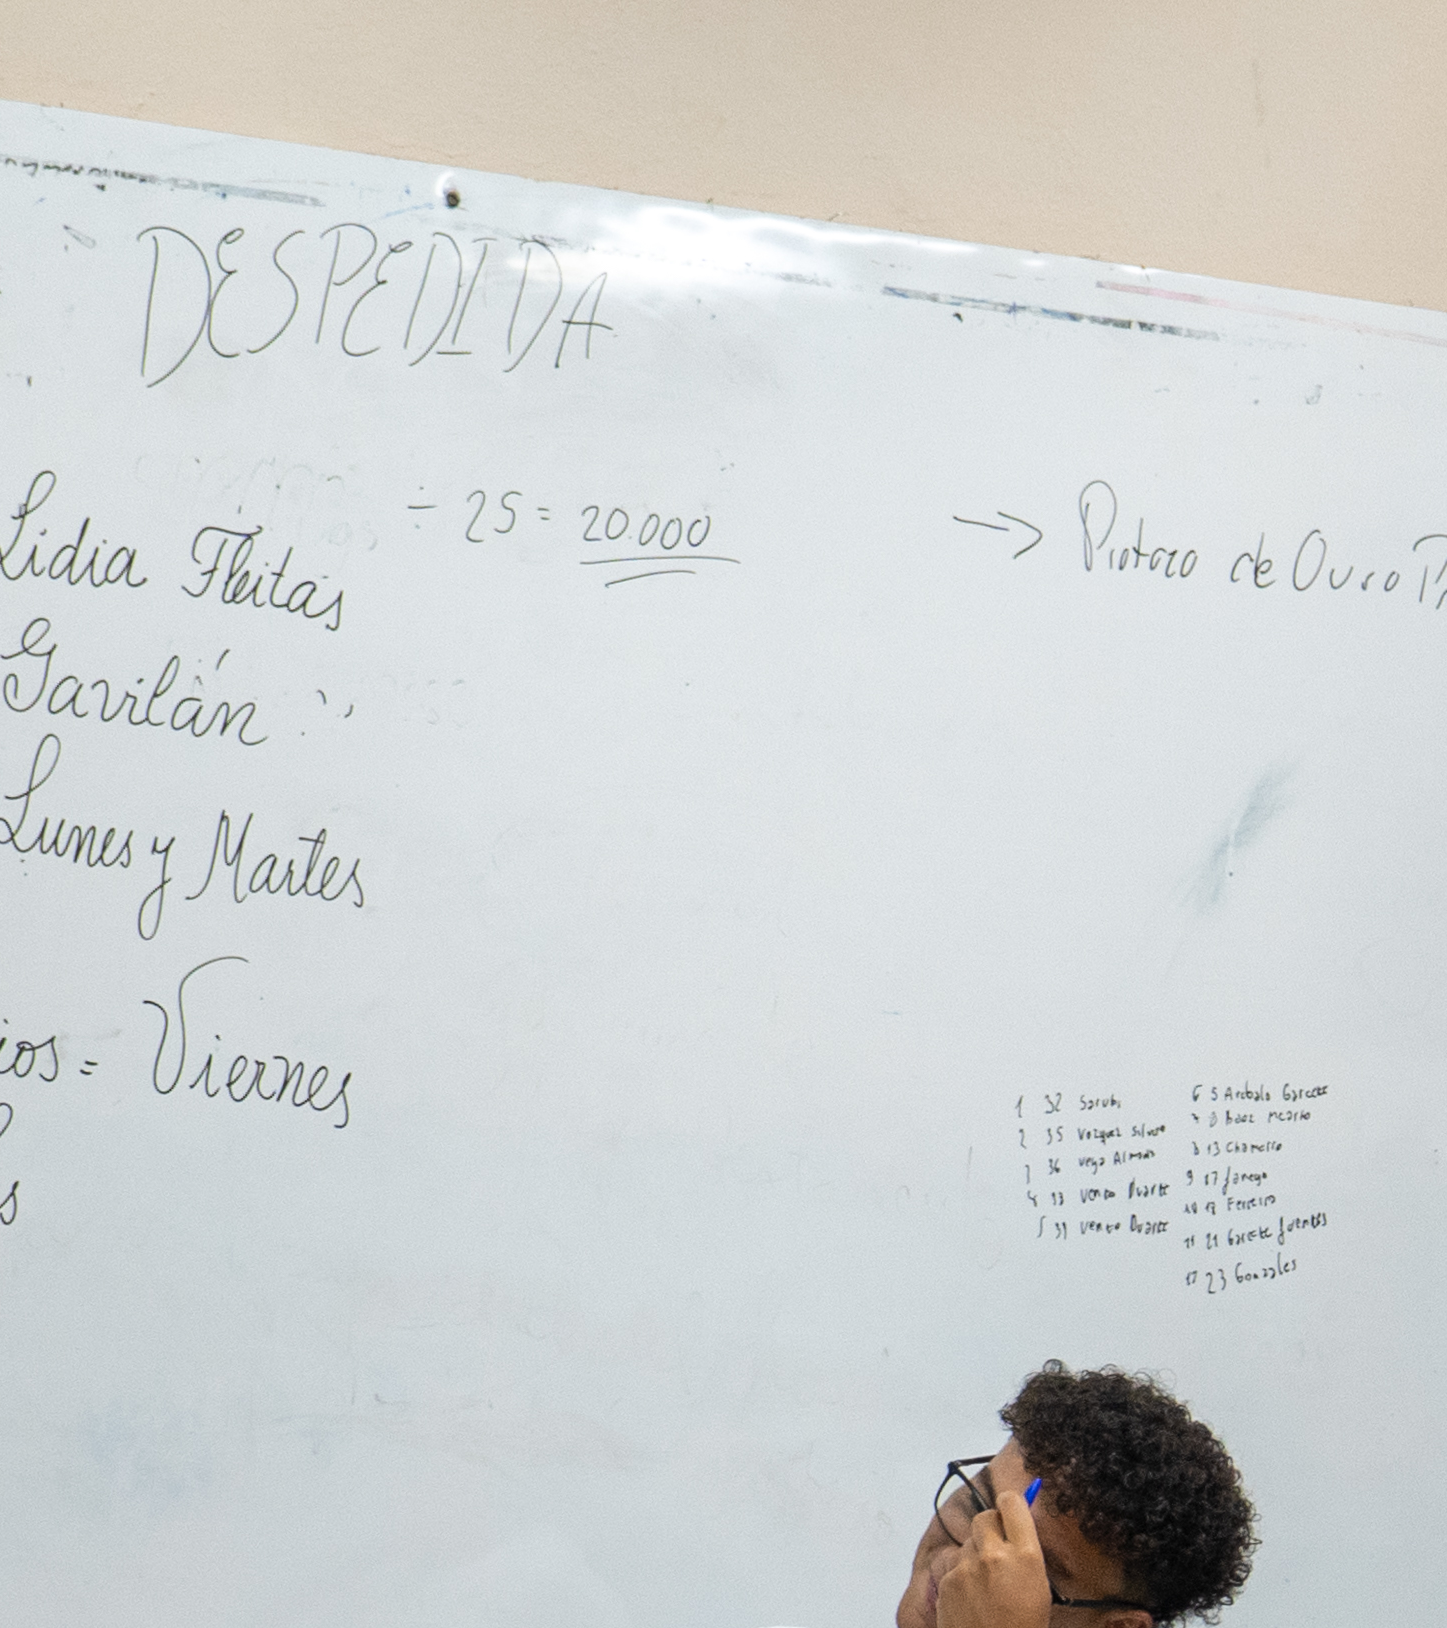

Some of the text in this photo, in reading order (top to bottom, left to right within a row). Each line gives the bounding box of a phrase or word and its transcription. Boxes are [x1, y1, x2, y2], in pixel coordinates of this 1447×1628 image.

[135, 222, 615, 390] DESPEDIDA
[465, 486, 523, 546] 25
[579, 502, 715, 552] 20.000
[1229, 528, 1278, 592] de
[0, 616, 269, 746] Gavilán
[136, 832, 172, 942] y
[183, 808, 367, 910] Martes
[141, 954, 353, 1130] Viernes
[1205, 1268, 1227, 1294] 23
